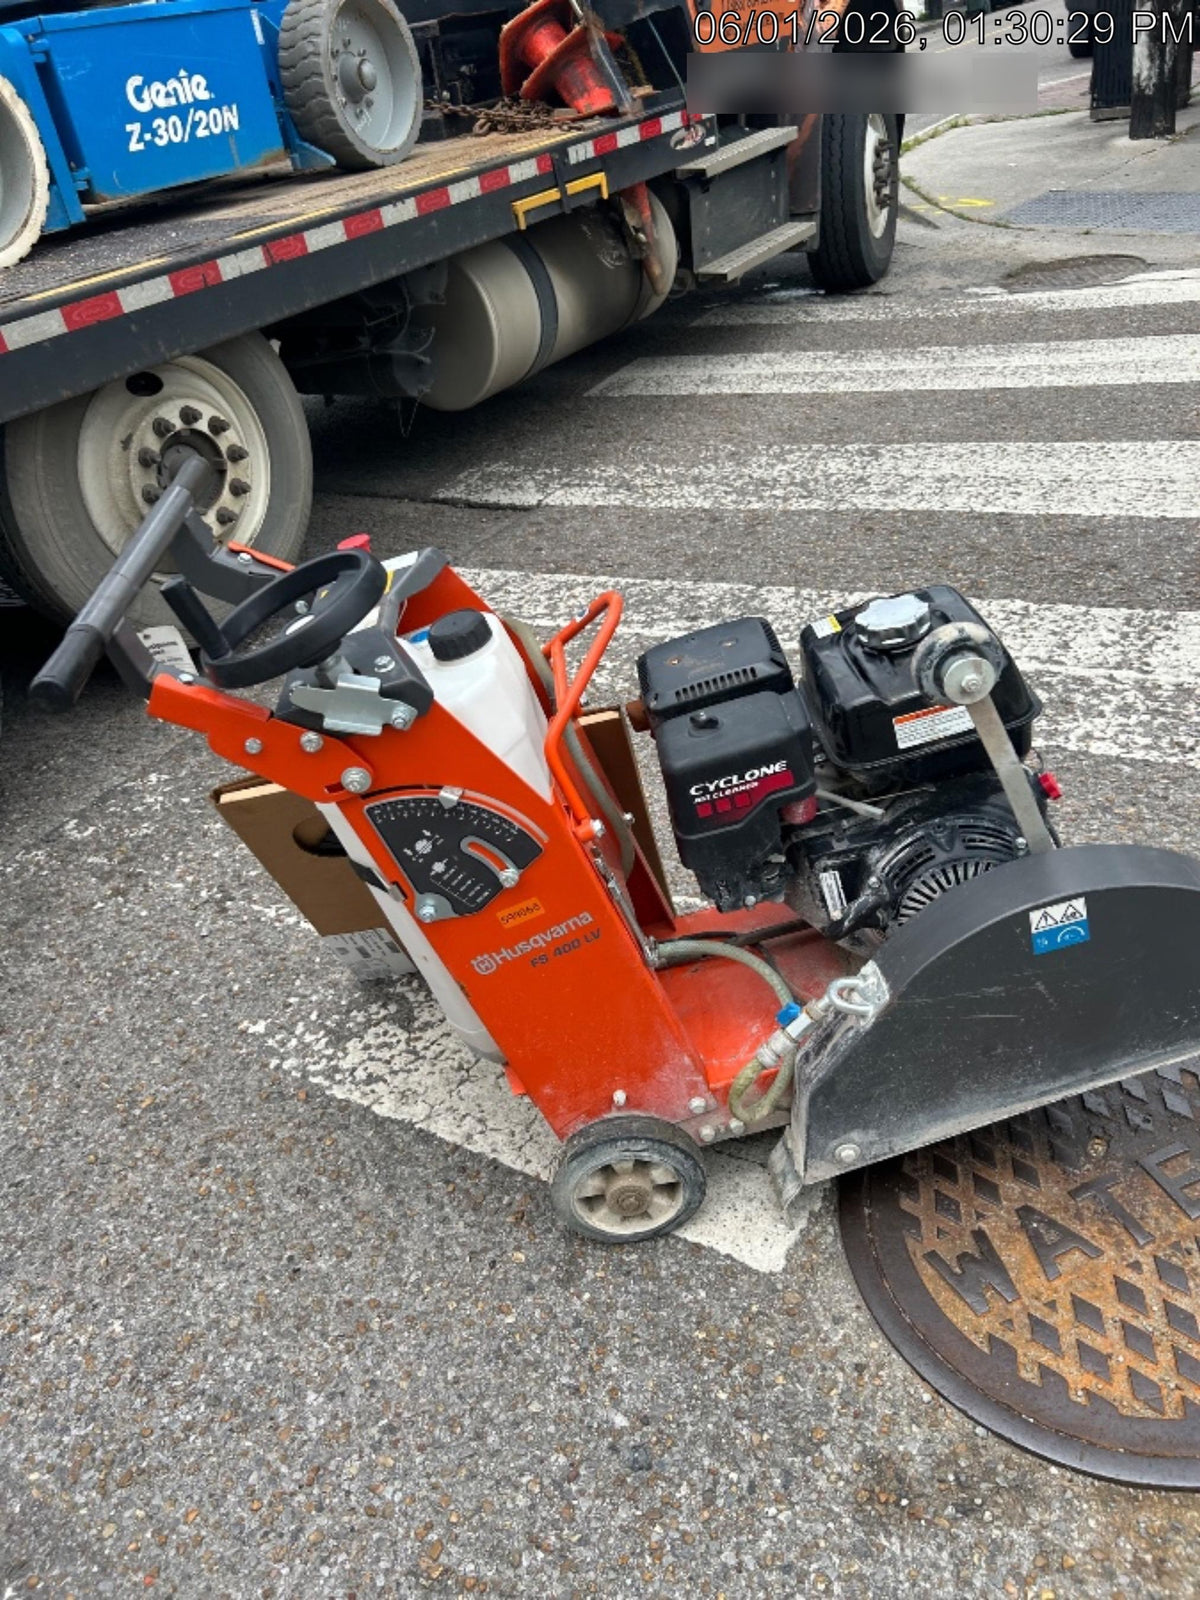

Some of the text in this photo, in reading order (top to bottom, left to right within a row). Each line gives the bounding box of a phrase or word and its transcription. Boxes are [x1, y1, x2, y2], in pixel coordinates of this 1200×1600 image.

[125, 68, 211, 113] Genie
[125, 103, 239, 152] Z-30/20N
[689, 760, 787, 796] CYCLONE
[491, 911, 593, 964] Husqvarna
[530, 928, 602, 968] FS 400 LV
